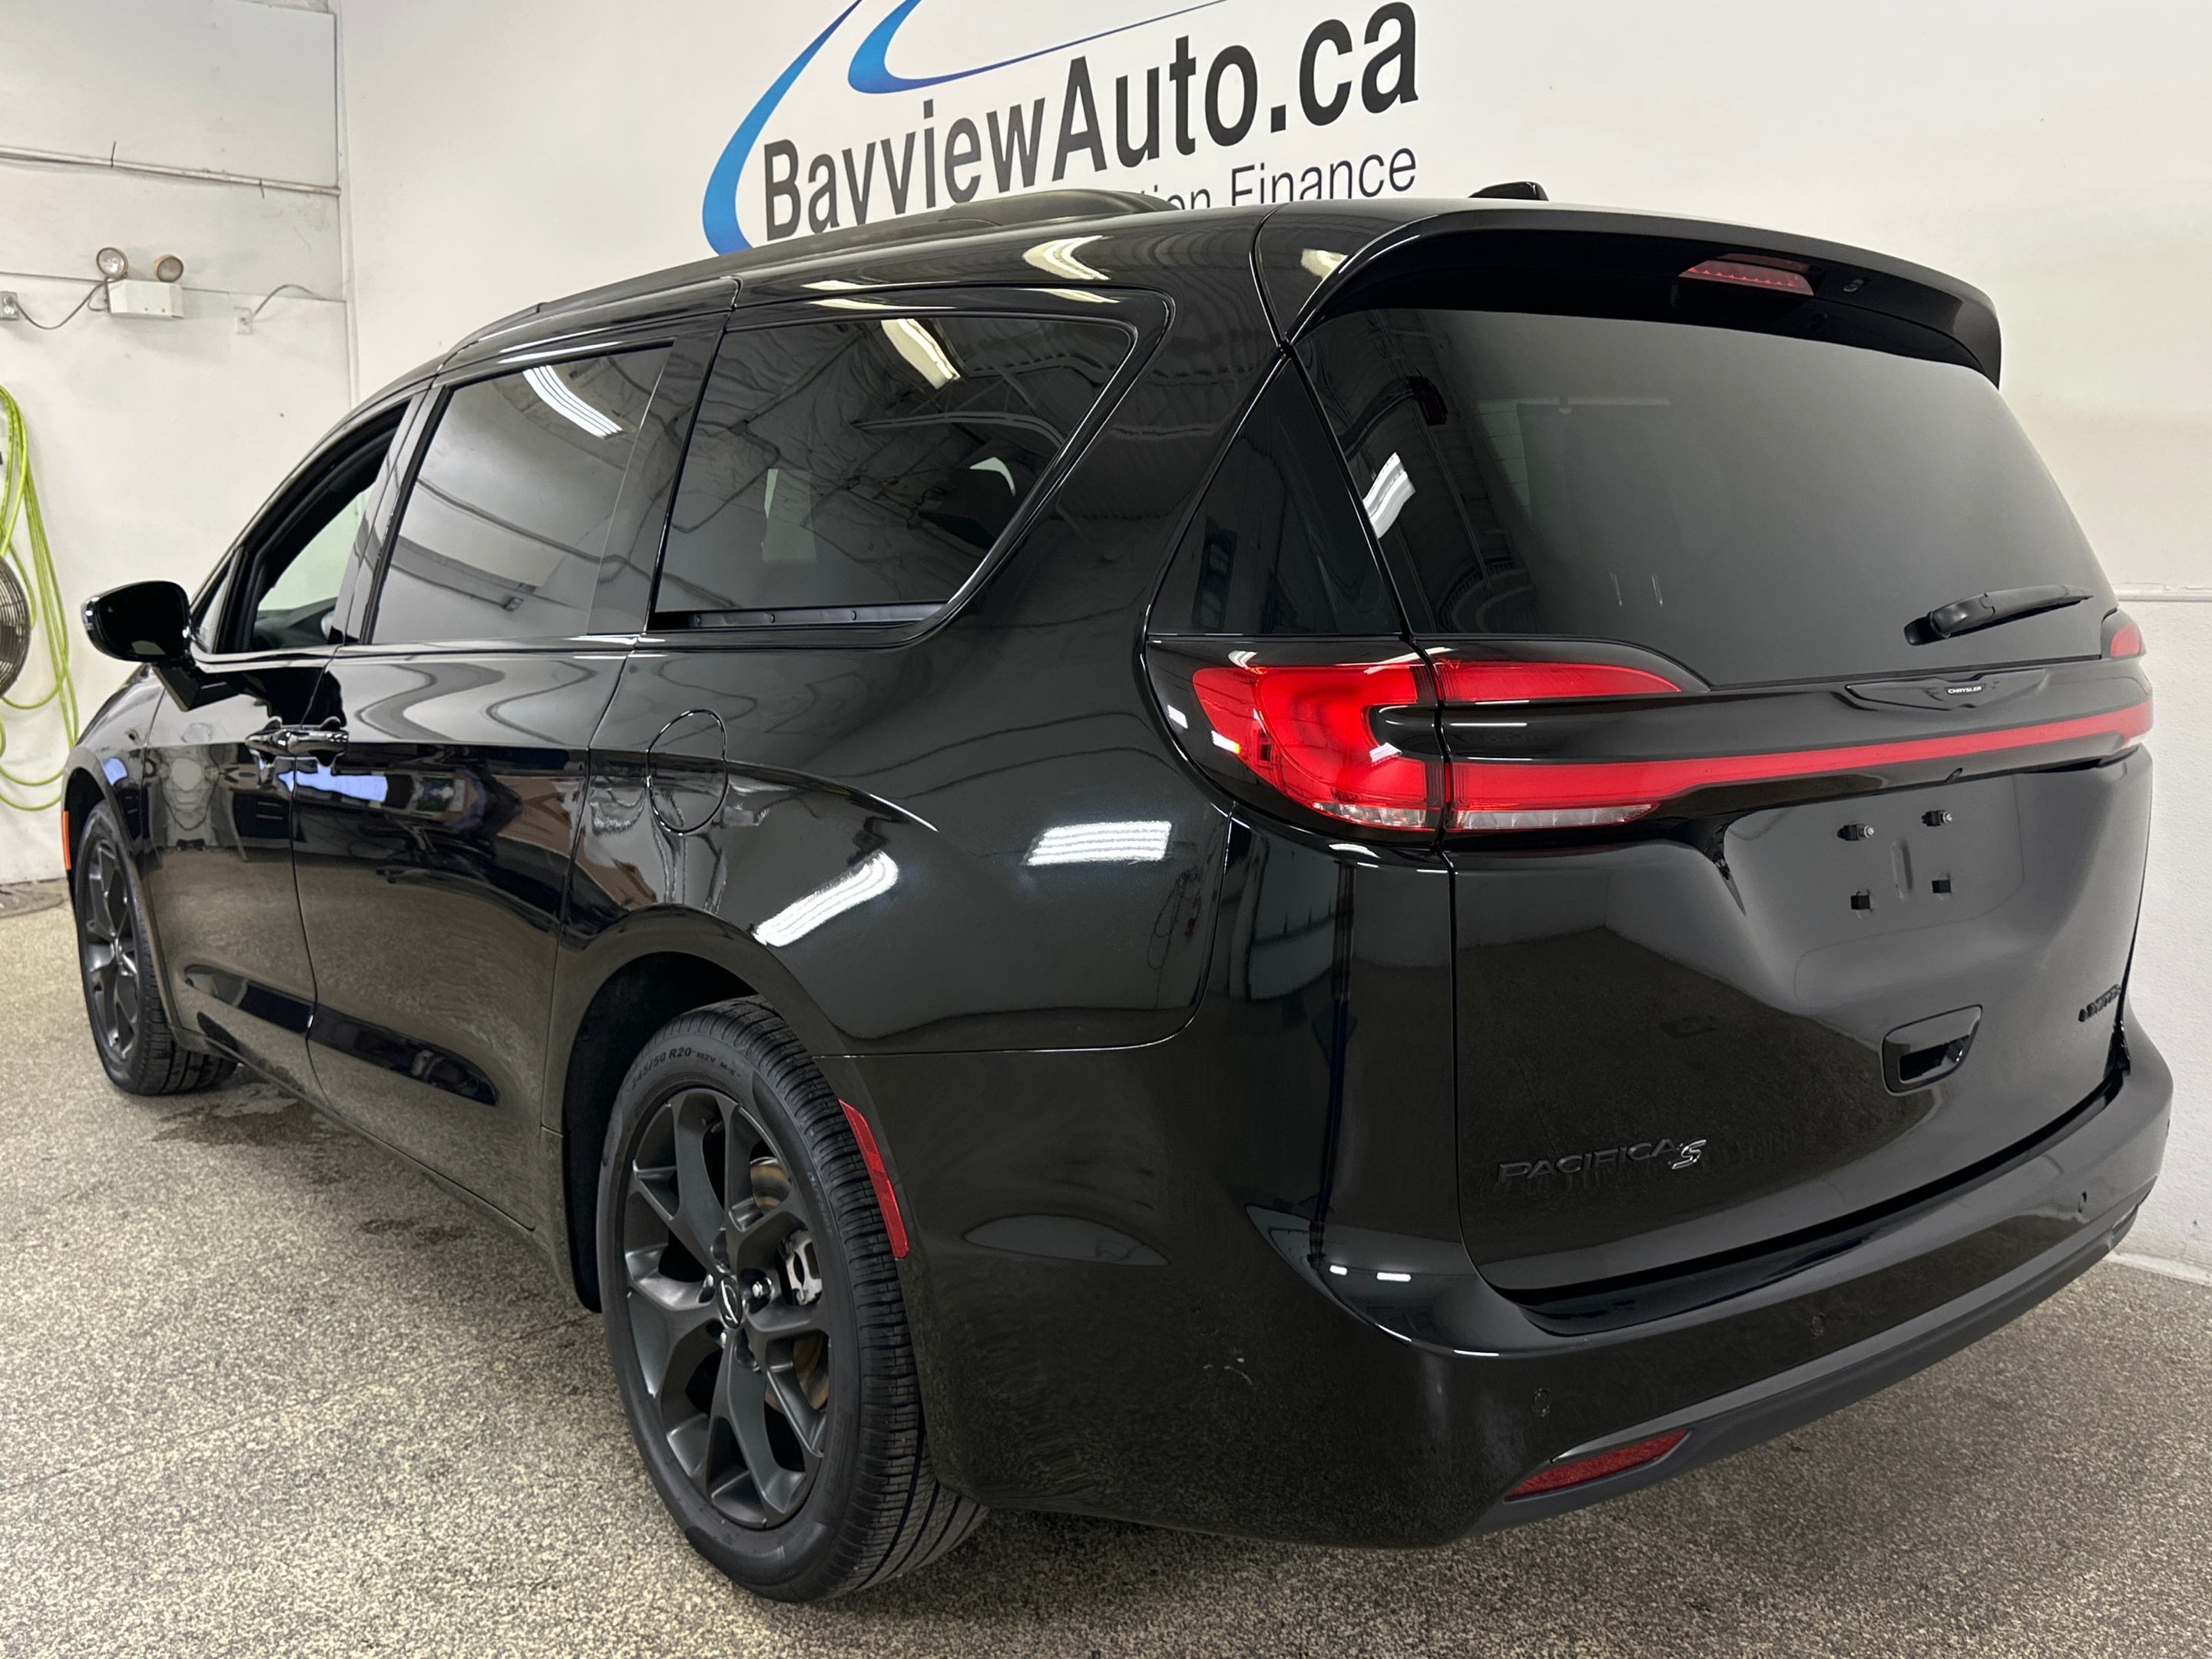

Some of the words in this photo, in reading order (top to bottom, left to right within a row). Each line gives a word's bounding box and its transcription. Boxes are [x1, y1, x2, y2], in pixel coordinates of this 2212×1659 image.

[764, 2, 1419, 241] BayviewAuto.ca
[1230, 147, 1416, 207] Finance
[669, 1046, 693, 1060] R20
[1498, 1137, 1674, 1183] PACIFICA
